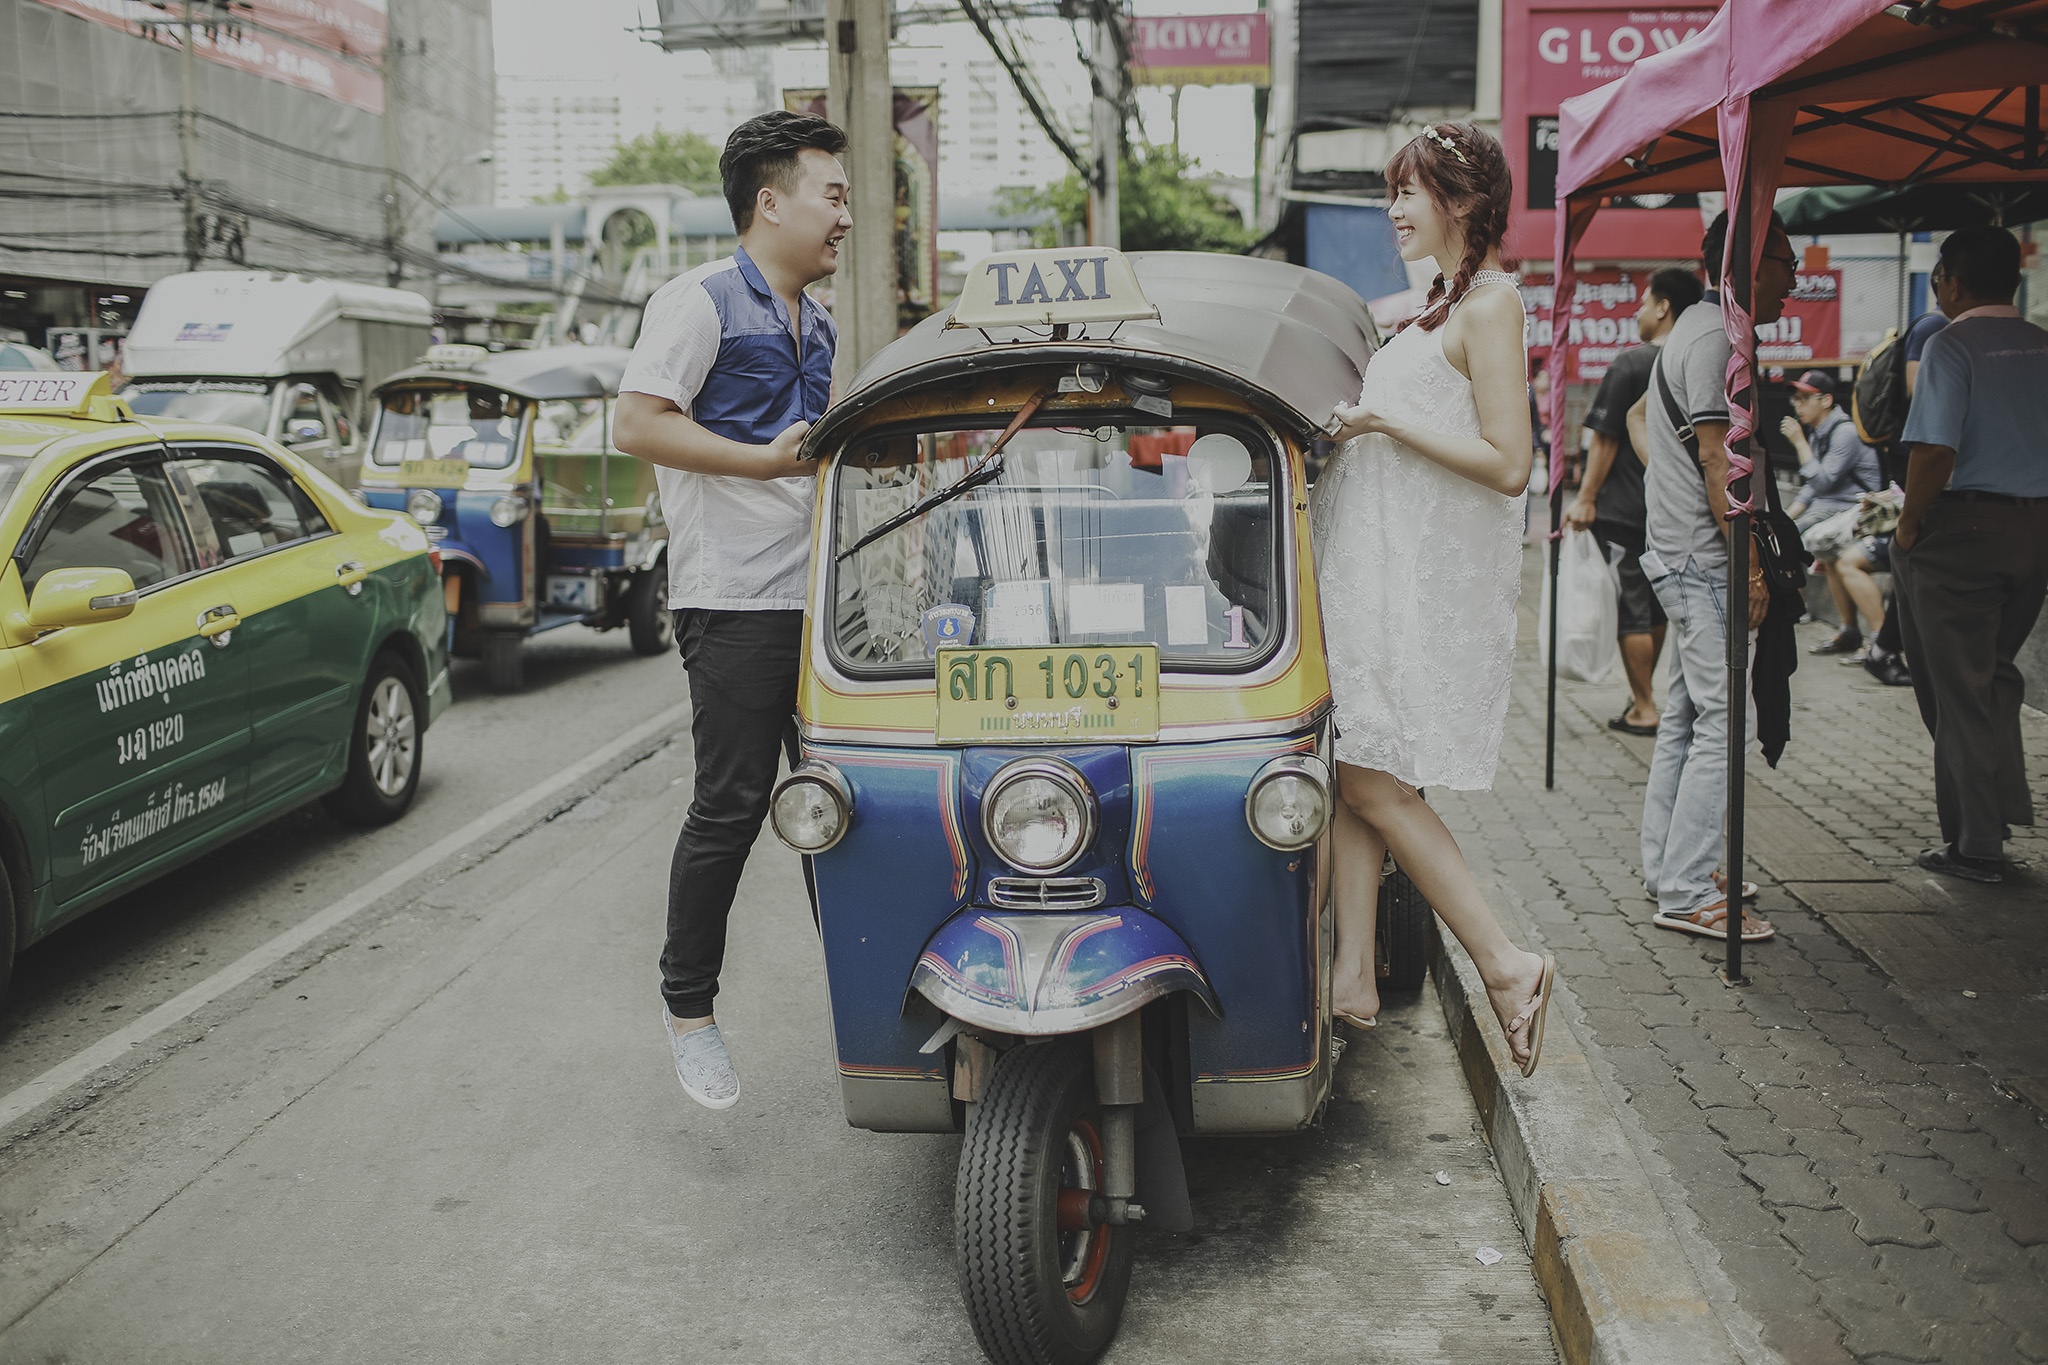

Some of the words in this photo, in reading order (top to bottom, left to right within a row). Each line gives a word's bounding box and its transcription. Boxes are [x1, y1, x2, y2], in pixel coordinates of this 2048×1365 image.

[986, 257, 1111, 305] TAXI
[1223, 605, 1251, 649] 1
[949, 653, 1014, 700] สก
[1039, 653, 1143, 699] 1031
